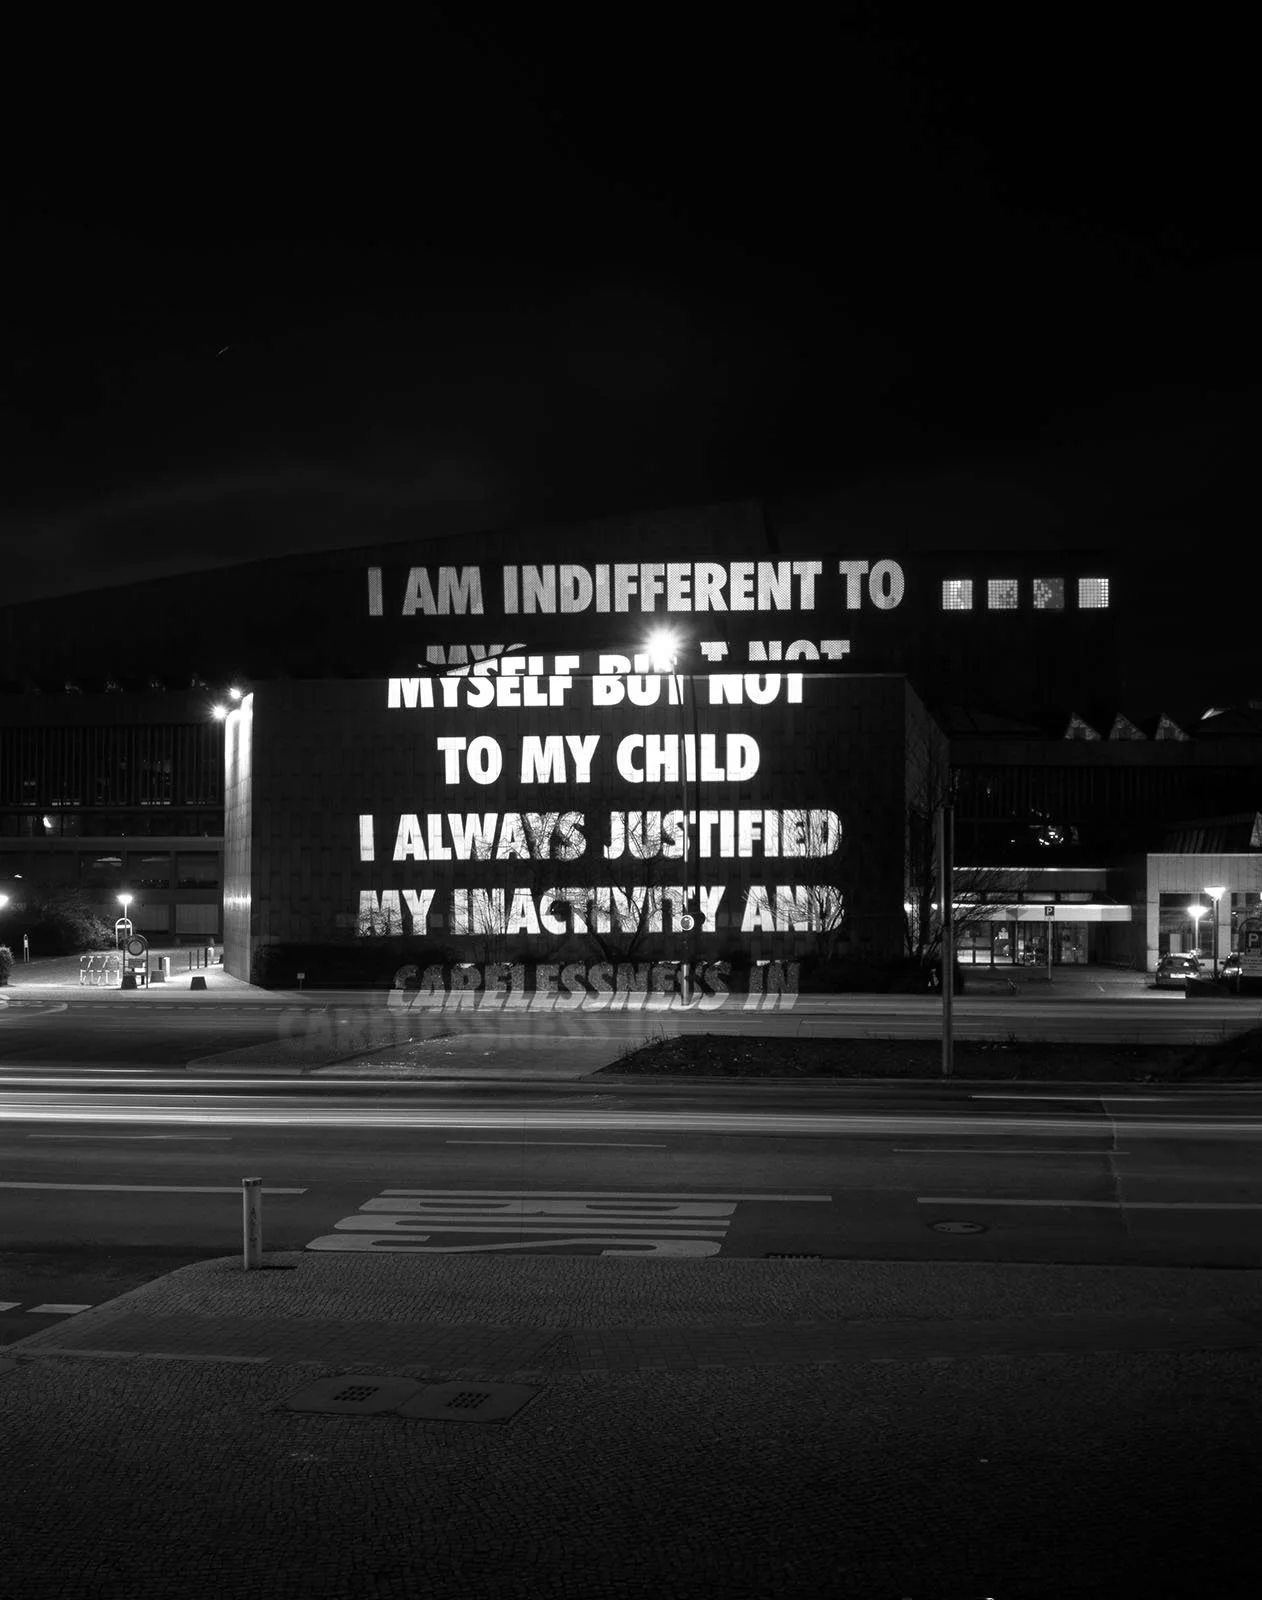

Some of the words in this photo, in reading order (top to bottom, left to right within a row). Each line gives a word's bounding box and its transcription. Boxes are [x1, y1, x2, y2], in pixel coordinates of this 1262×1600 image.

[368, 569, 383, 616] I
[402, 566, 484, 615] AM
[503, 561, 823, 614] INDIFFERENT
[839, 559, 905, 611] TO
[387, 643, 581, 709] MYSELF
[708, 640, 851, 705] NOT
[436, 735, 503, 785] TO
[520, 734, 600, 784] MY
[616, 733, 761, 784] CHILD
[359, 814, 375, 861] I
[392, 811, 587, 861] ALWAYS
[603, 809, 843, 861] JUSTIFIED
[358, 889, 436, 936] MY
[452, 886, 726, 935] INACTIVITY
[741, 885, 845, 933] AND
[1248, 932, 1259, 948] P
[387, 961, 732, 1012] CARELESSNESS
[743, 960, 800, 1010] IN
